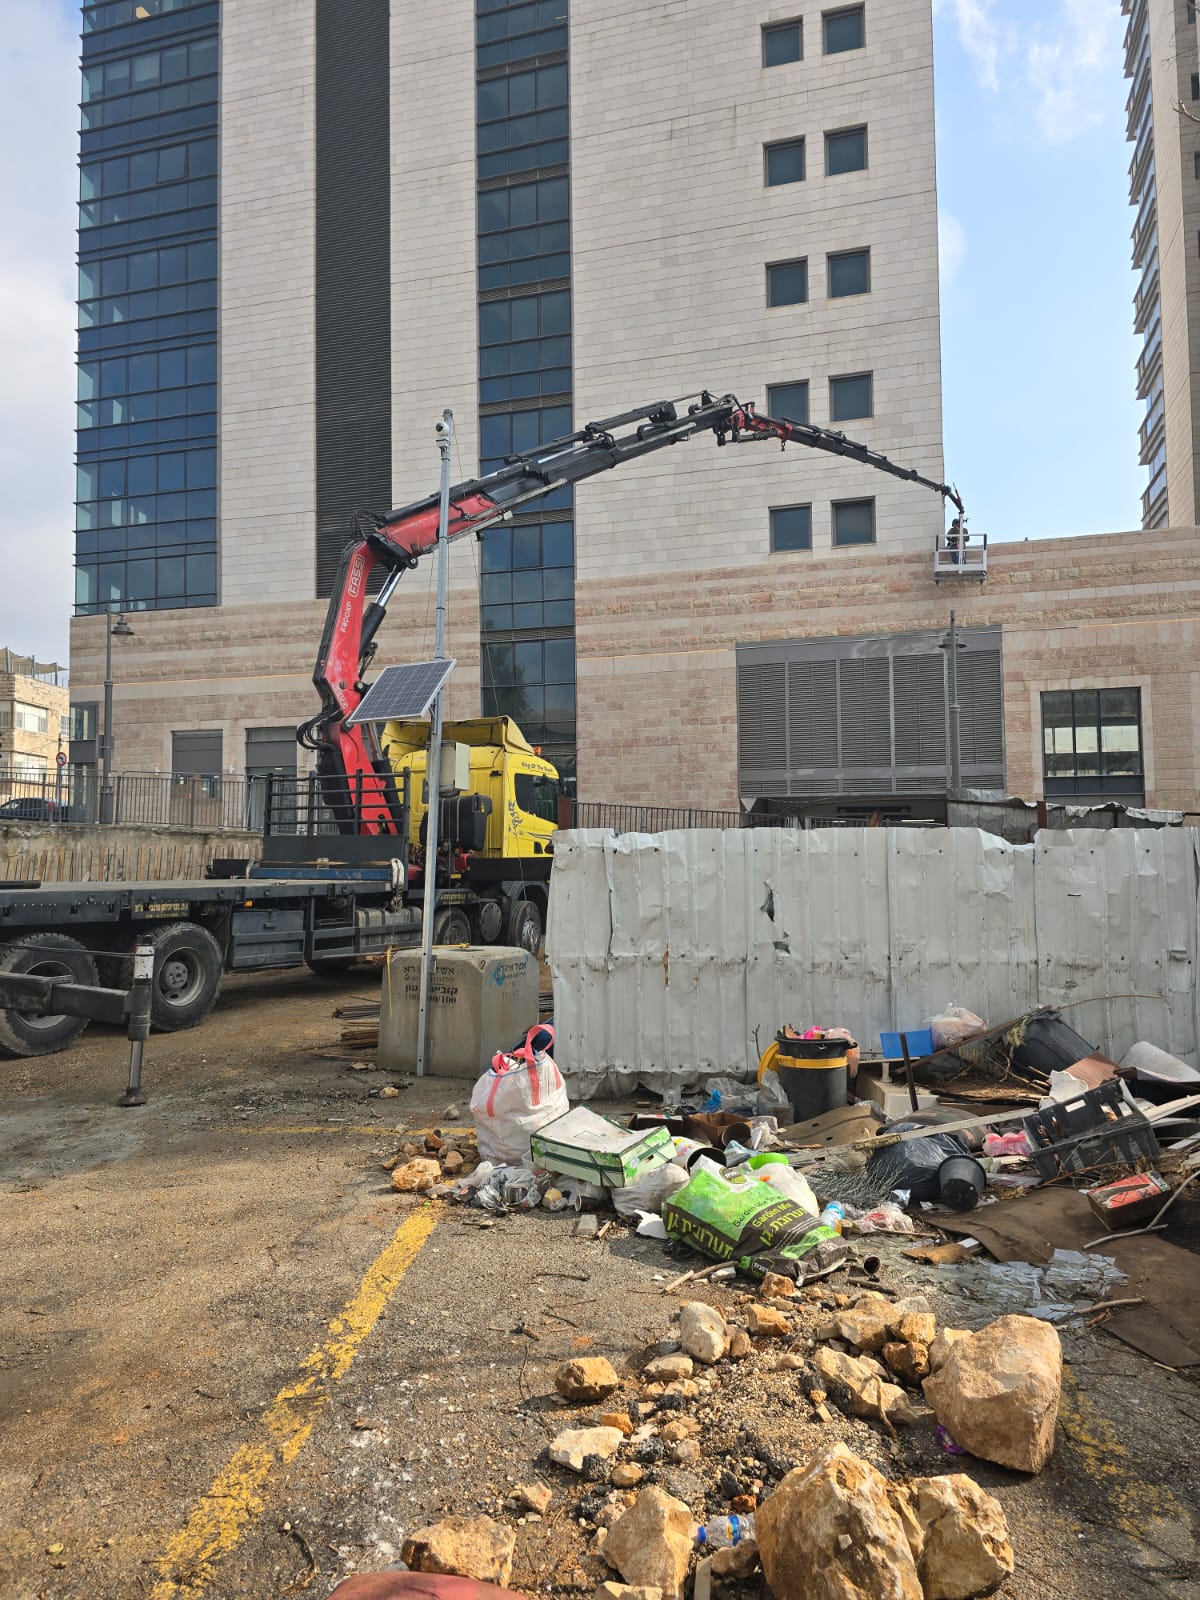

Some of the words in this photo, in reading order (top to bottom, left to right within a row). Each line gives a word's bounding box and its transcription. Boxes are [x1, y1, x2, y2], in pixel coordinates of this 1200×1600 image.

[349, 555, 364, 596] FASSI
[667, 1212, 678, 1231] גן
[752, 1208, 782, 1228] Garden
[778, 1202, 792, 1213] Mix
[682, 1218, 735, 1260] תערובת
[759, 1228, 774, 1247] גן
